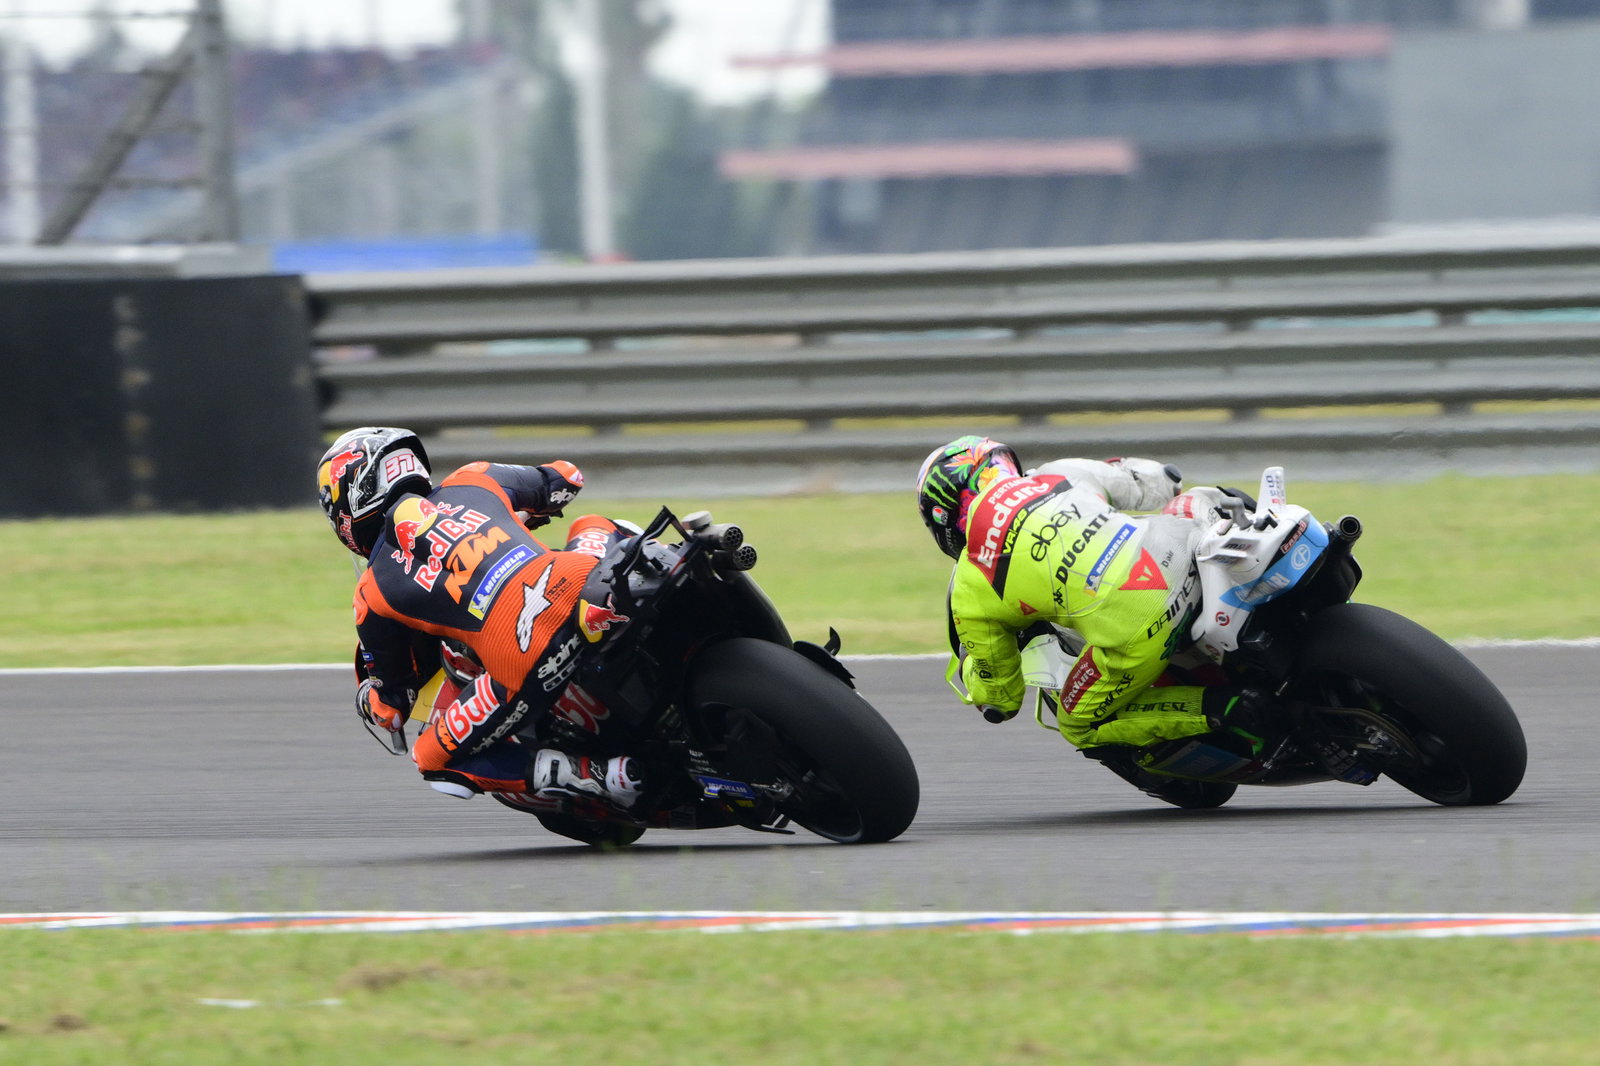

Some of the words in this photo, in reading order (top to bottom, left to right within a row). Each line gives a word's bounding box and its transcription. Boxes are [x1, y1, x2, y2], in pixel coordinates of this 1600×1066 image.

[385, 453, 415, 484] 37
[414, 530, 453, 593] Red
[436, 508, 491, 542] Bull
[977, 483, 1050, 569] Enduro
[1031, 503, 1081, 562] ebay
[1056, 513, 1109, 585] DUCATI
[1096, 528, 1130, 575] MICHELIN
[444, 526, 511, 605] KTM
[484, 550, 526, 596] MICHELIN
[1147, 566, 1198, 639] DAINES
[445, 672, 500, 744] Bull
[1063, 667, 1095, 709] Enduro
[1125, 701, 1189, 713] DAINESE
